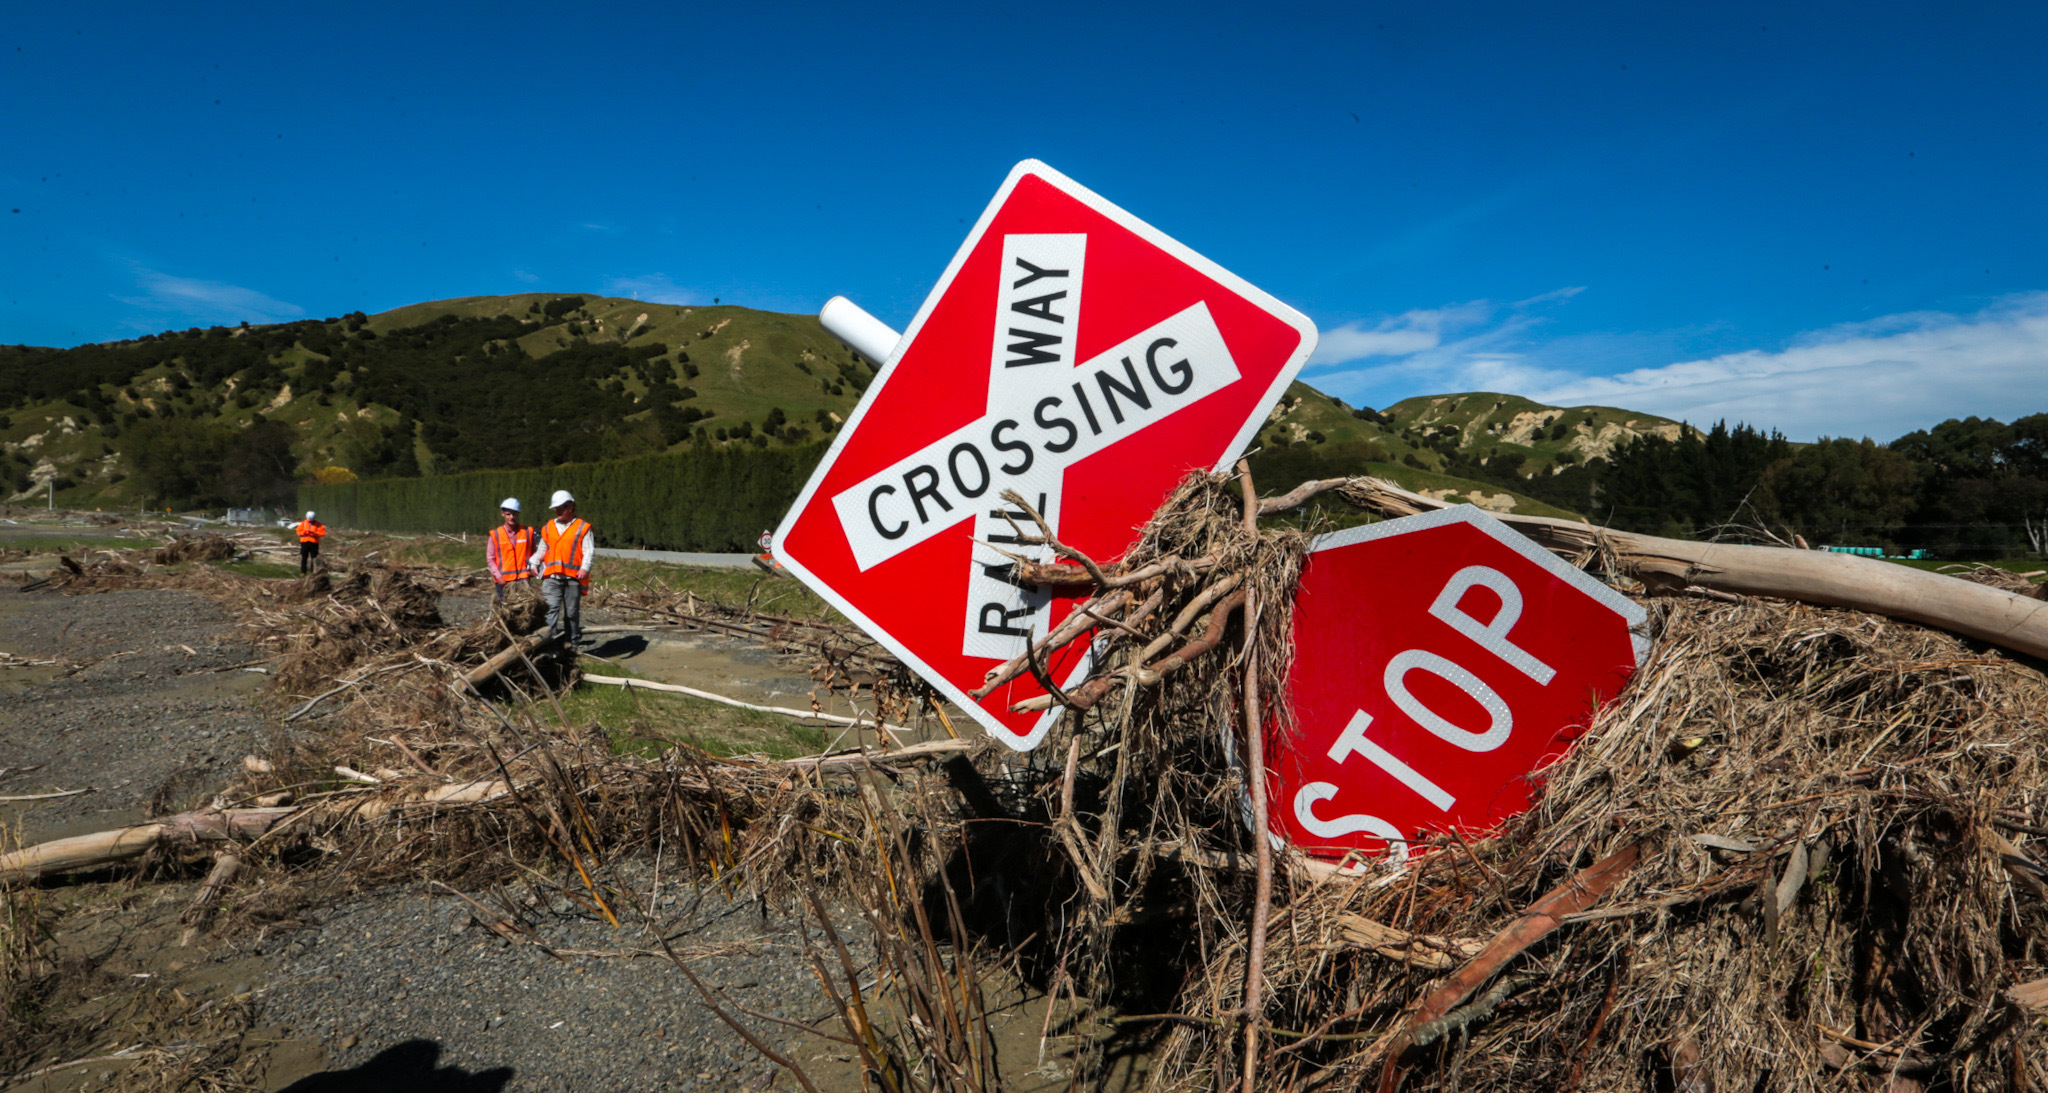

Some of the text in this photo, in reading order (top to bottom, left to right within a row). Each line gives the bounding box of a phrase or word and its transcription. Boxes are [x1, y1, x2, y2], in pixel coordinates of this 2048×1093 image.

[867, 337, 1193, 541] CROSSING
[978, 257, 1069, 638] RAIL WAY
[1294, 565, 1557, 872] STOP
